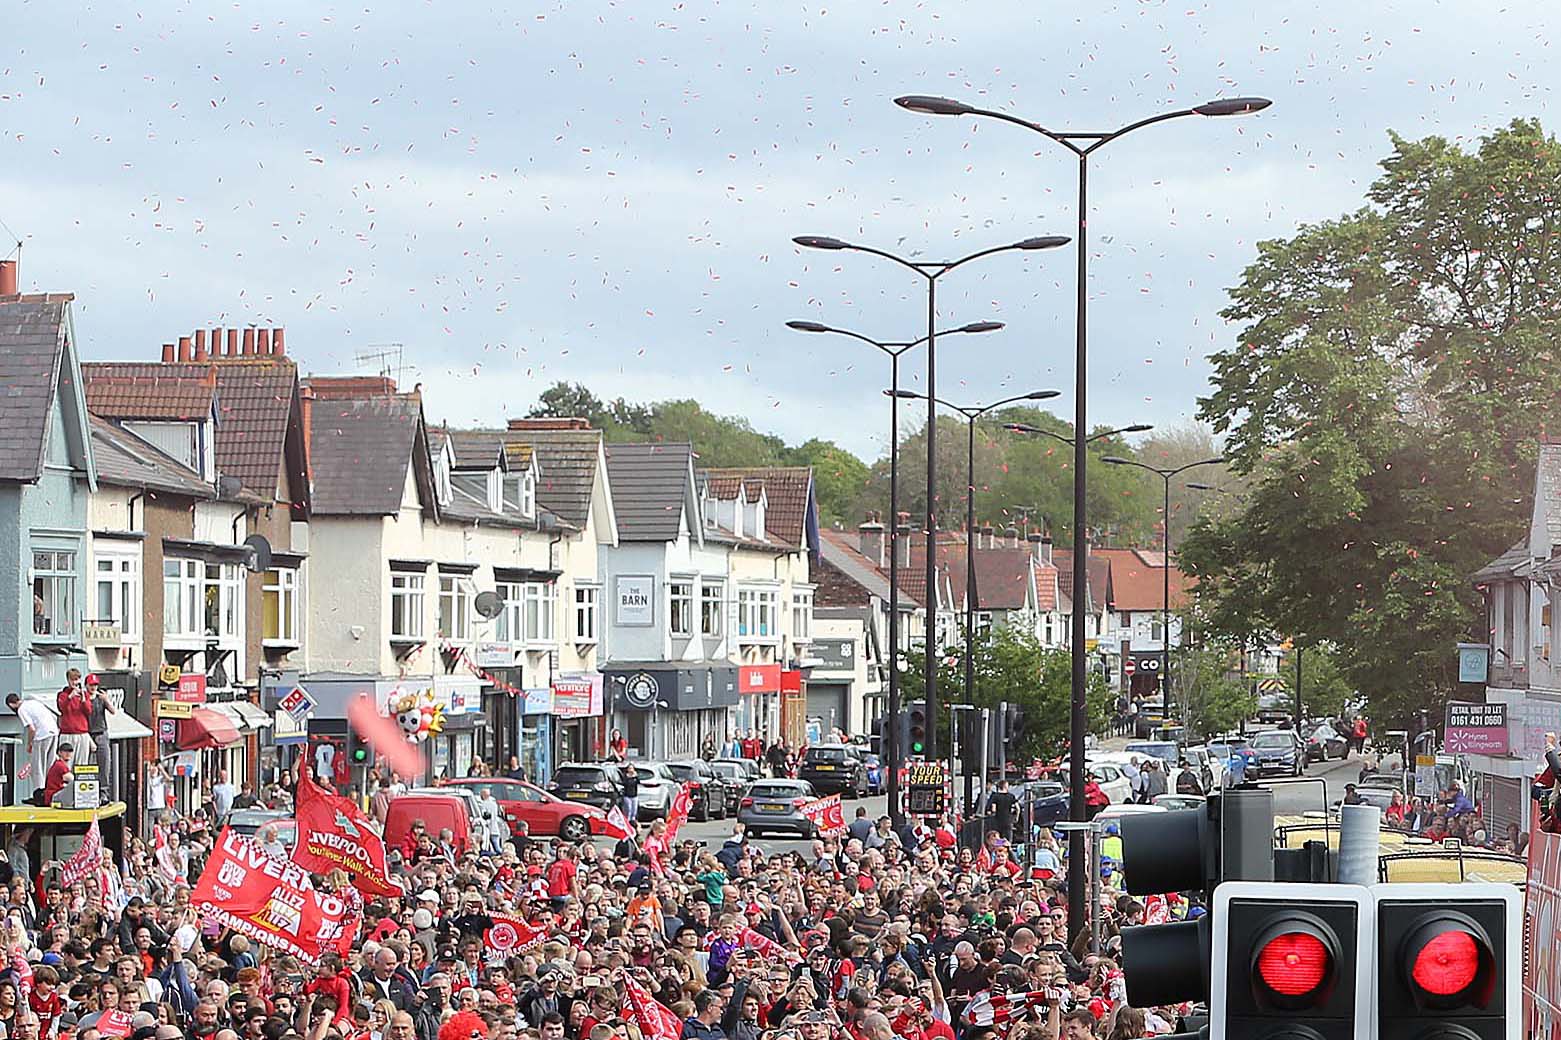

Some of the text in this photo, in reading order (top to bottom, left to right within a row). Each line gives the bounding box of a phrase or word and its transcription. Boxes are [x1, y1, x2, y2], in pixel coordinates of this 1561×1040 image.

[622, 595, 648, 606] BARN
[85, 630, 117, 640] MARAY
[1451, 706, 1469, 715] RETAIL
[1484, 706, 1492, 714] TO
[1469, 716, 1483, 725] 431
[913, 766, 941, 776] YOUR
[911, 775, 943, 785] SPEED
[200, 902, 290, 951] CHAMPIONS
